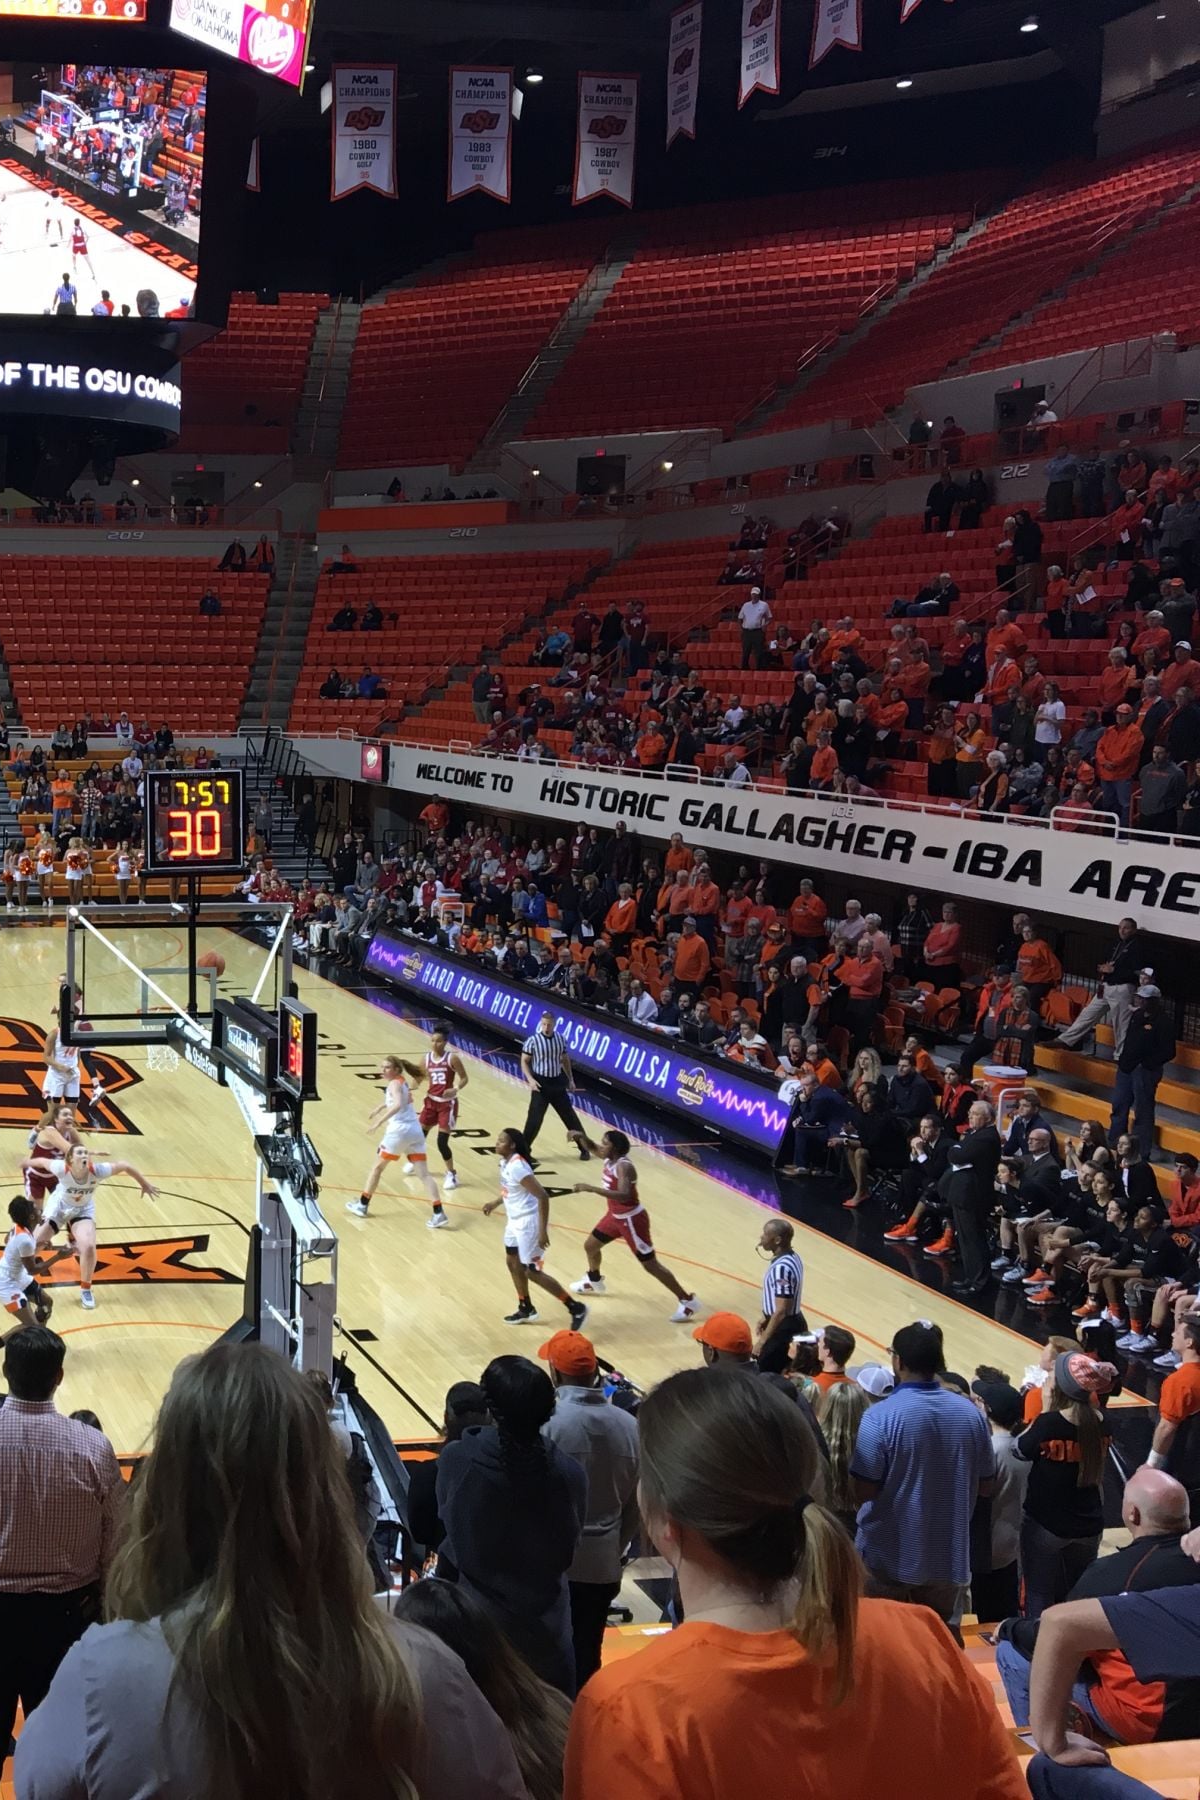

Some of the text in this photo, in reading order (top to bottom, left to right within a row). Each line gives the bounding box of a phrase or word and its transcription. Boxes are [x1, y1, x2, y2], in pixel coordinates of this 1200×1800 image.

[193, 0, 231, 24] BANK OF
[191, 13, 239, 46] OKLAHOMA
[351, 75, 379, 84] NCAA
[468, 77, 495, 87] NCAA
[339, 87, 391, 97] CHAMPIONS
[455, 89, 507, 99] CHAMPIONS
[584, 95, 633, 106] CHAMPIONS
[353, 140, 377, 150] 1980
[349, 152, 381, 161] COWBOY
[595, 147, 618, 158] 1987
[813, 145, 847, 159] 314
[464, 155, 495, 163] COWBOY
[590, 160, 620, 168] COWBOY
[471, 163, 487, 171] GOLF
[26, 362, 81, 390] THE
[84, 367, 131, 395] OSU
[1001, 463, 1030, 479] 212
[730, 503, 747, 514] 211
[107, 531, 145, 540] 209
[449, 527, 479, 537] 210
[175, 781, 229, 806] 7:57
[416, 763, 487, 788] WELCOME
[491, 773, 513, 793] TO
[539, 777, 670, 822] HISTORIC
[678, 798, 1042, 887] GALLAGHER-IBA
[169, 810, 220, 857] 30
[422, 962, 454, 993] HARD
[454, 976, 490, 1009] ROCK
[490, 990, 533, 1029] HOTEL
[614, 1041, 671, 1089] TULSA
[431, 1072, 447, 1085] 22
